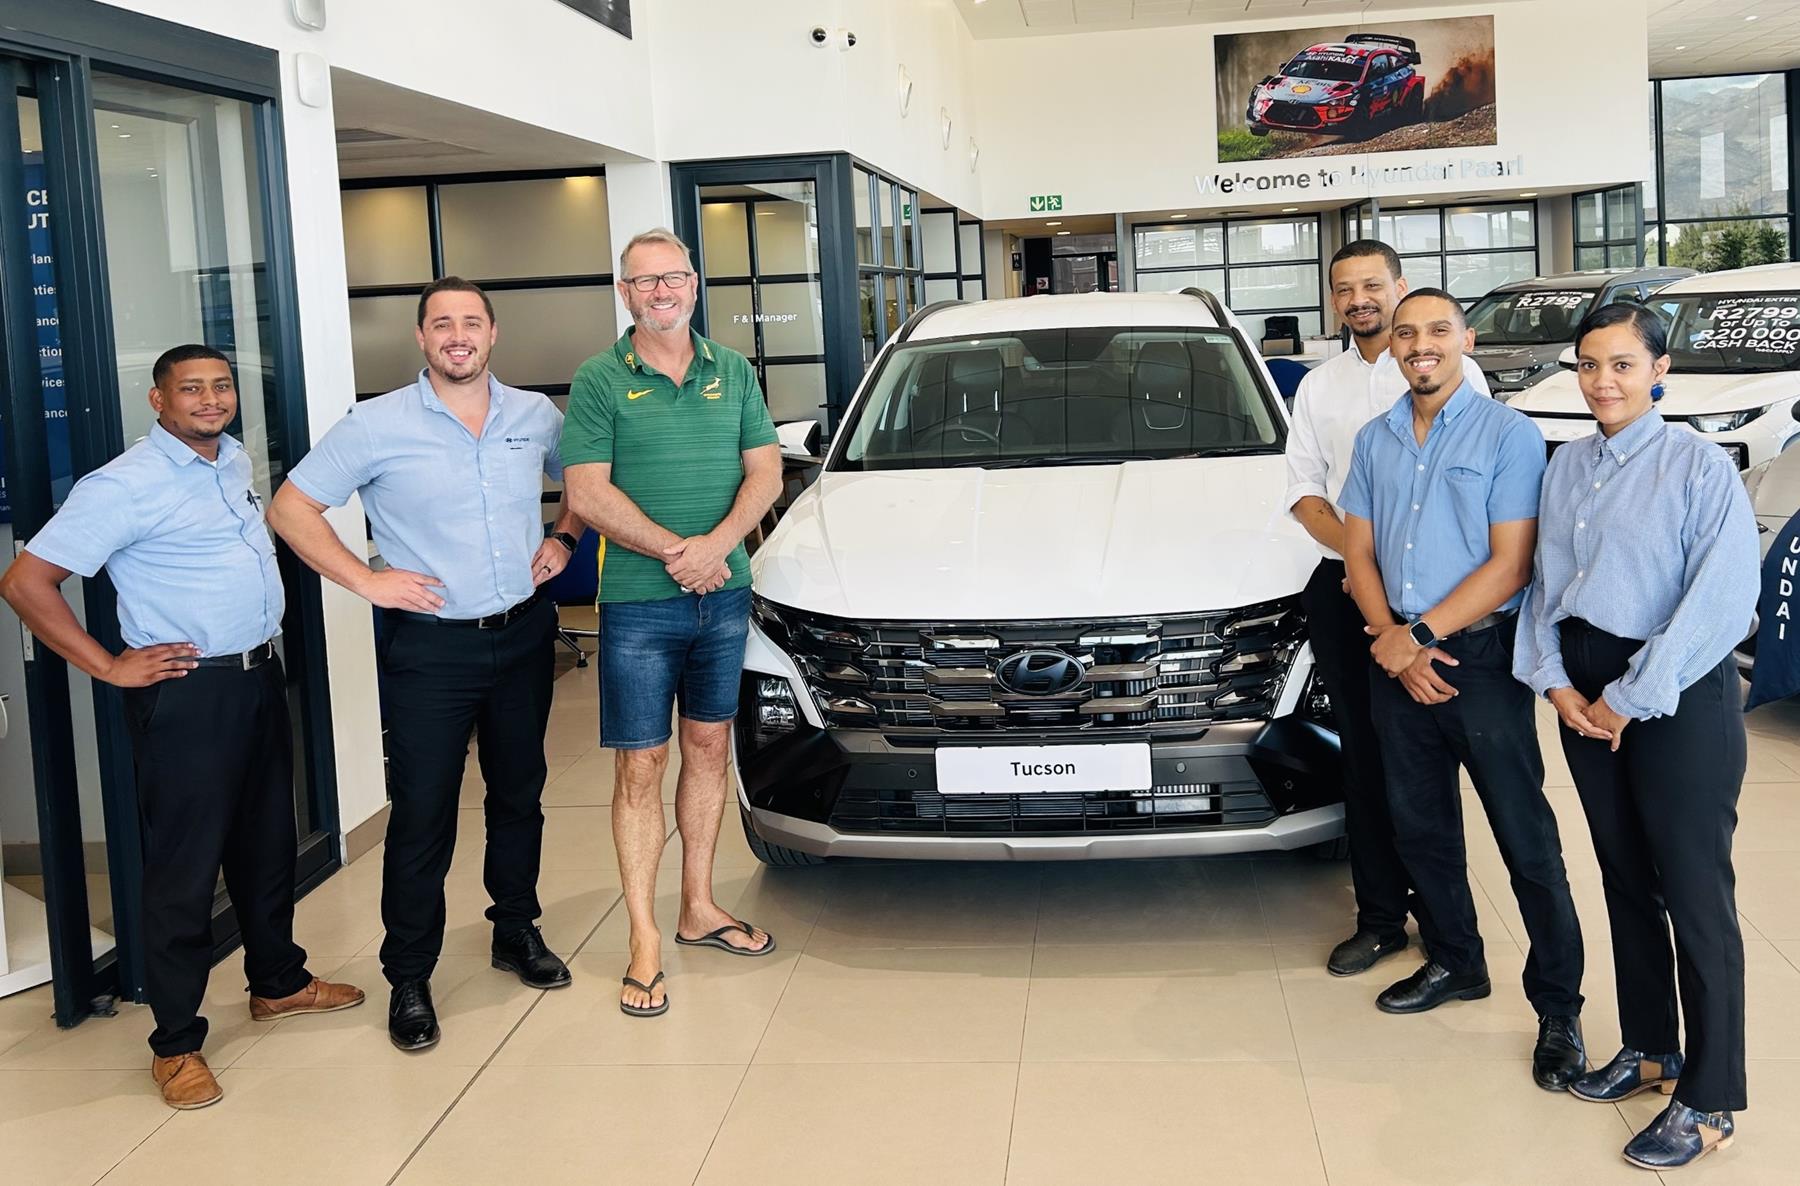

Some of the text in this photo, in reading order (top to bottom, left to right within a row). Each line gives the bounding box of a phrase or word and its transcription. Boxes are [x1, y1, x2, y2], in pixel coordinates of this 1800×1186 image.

[1195, 154, 1524, 195] Welcome to Hyundai Paarl
[1516, 296, 1582, 308] R2799
[733, 314, 740, 324] F
[741, 314, 749, 323] &
[755, 312, 798, 323] Manager
[1708, 307, 1798, 321] R2799
[1720, 318, 1792, 328] or Up To
[1693, 339, 1799, 350] CASH BACK
[1010, 762, 1075, 776] Tucson
